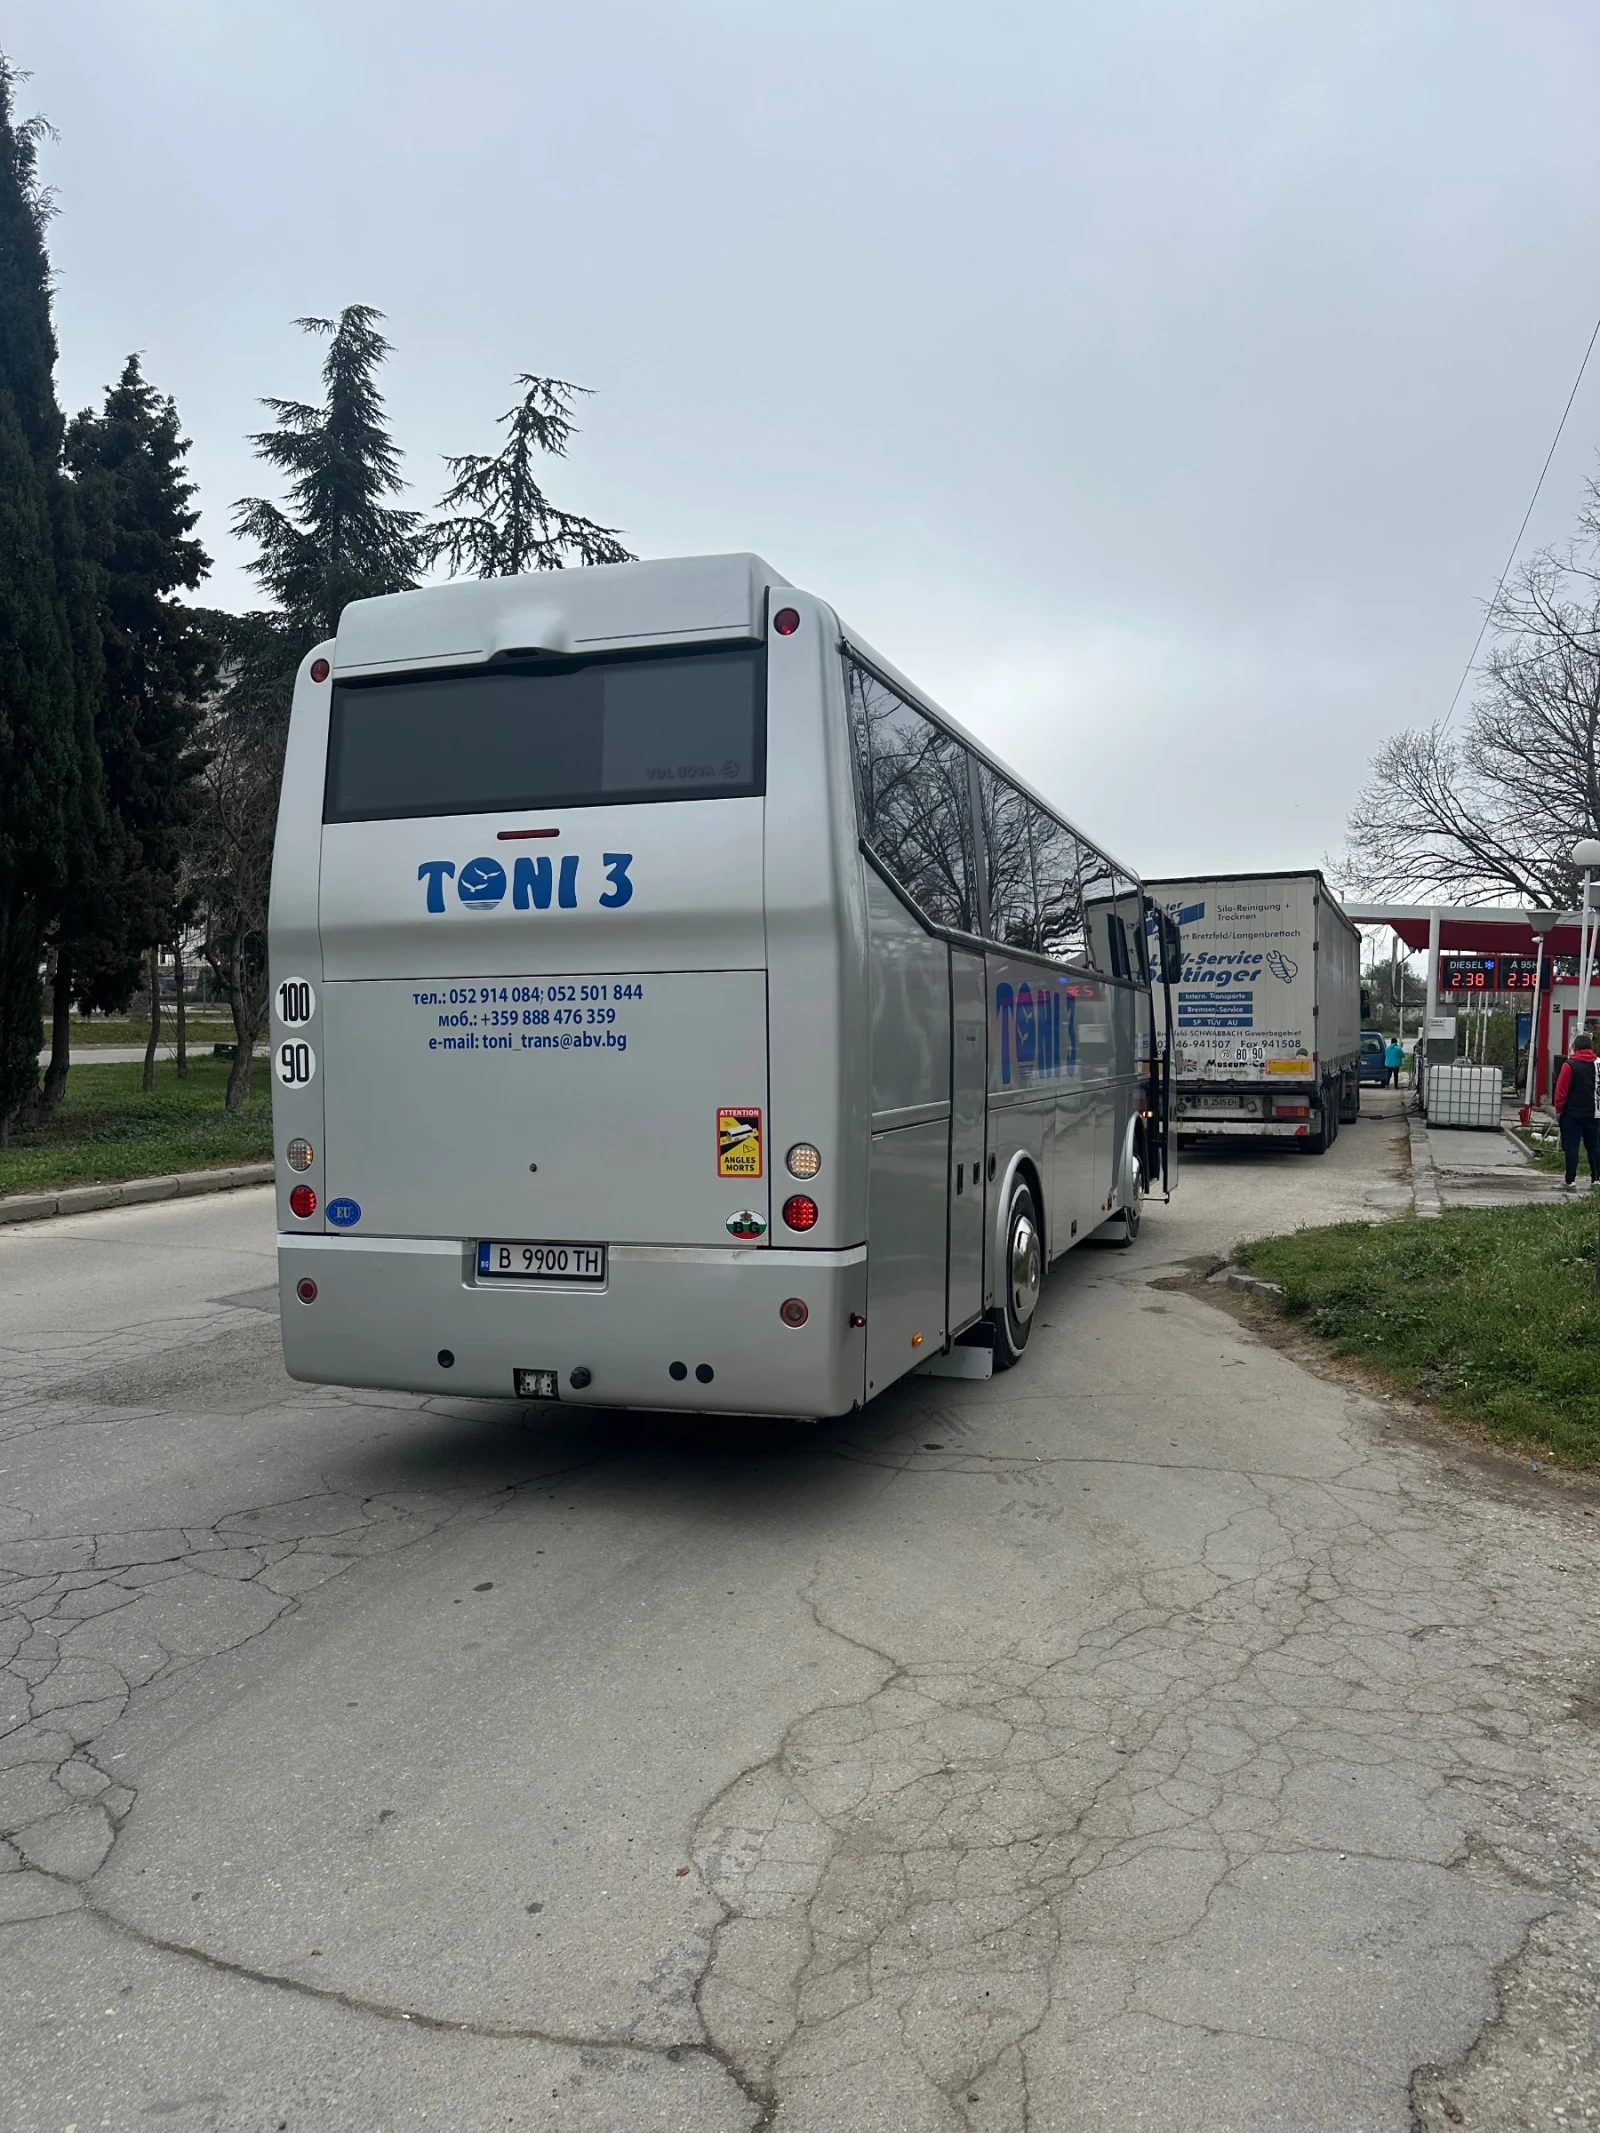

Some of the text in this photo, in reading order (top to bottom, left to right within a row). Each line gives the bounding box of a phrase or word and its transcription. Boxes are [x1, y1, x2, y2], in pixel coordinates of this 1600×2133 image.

[418, 852, 634, 914] TONI 3
[1217, 902, 1281, 913] Silo-Reinigung
[1217, 913, 1256, 921] Trocknen
[1450, 961, 1484, 969] DIESEL
[1510, 961, 1518, 969] A
[1452, 973, 1485, 986] 2.38
[413, 984, 644, 1005] тел.: 052 914 084; 052 501 844
[279, 982, 310, 1022] 100
[438, 1008, 617, 1027] моб.: +359 888 476 359
[995, 982, 1077, 1085] TONI 3
[1245, 1030, 1302, 1038] Gewerbegebiet
[428, 1030, 627, 1051] e-mail: toni_trans@abv.bg
[1241, 1040, 1258, 1048] Fax
[1262, 1039, 1302, 1049] 941508
[1236, 1048, 1247, 1061] 80
[1252, 1047, 1263, 1060] 90
[281, 1043, 309, 1083] 90
[719, 1109, 759, 1117] ATTENTION
[724, 1156, 756, 1164] ANGLES
[726, 1164, 755, 1172] MORTS
[336, 1206, 351, 1219] EU
[732, 1221, 760, 1235] BG
[499, 1247, 599, 1273] B 9900 TH
